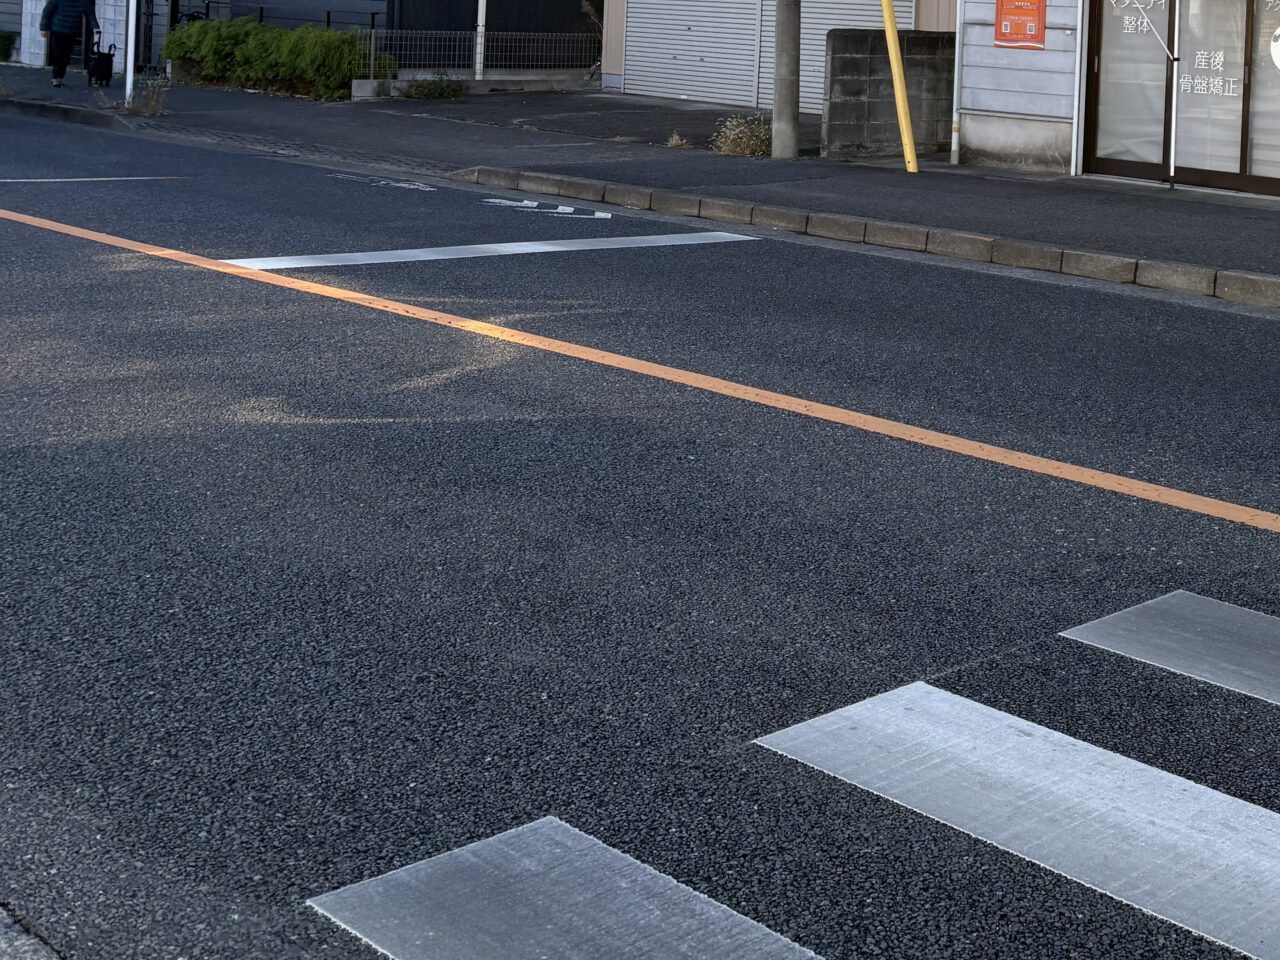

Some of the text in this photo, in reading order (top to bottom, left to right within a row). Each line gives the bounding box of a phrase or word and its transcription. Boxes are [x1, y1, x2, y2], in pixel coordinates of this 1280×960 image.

[1122, 15, 1151, 34] 整体
[1194, 49, 1225, 71] 産後
[1179, 74, 1239, 98] 骨盤矯正
